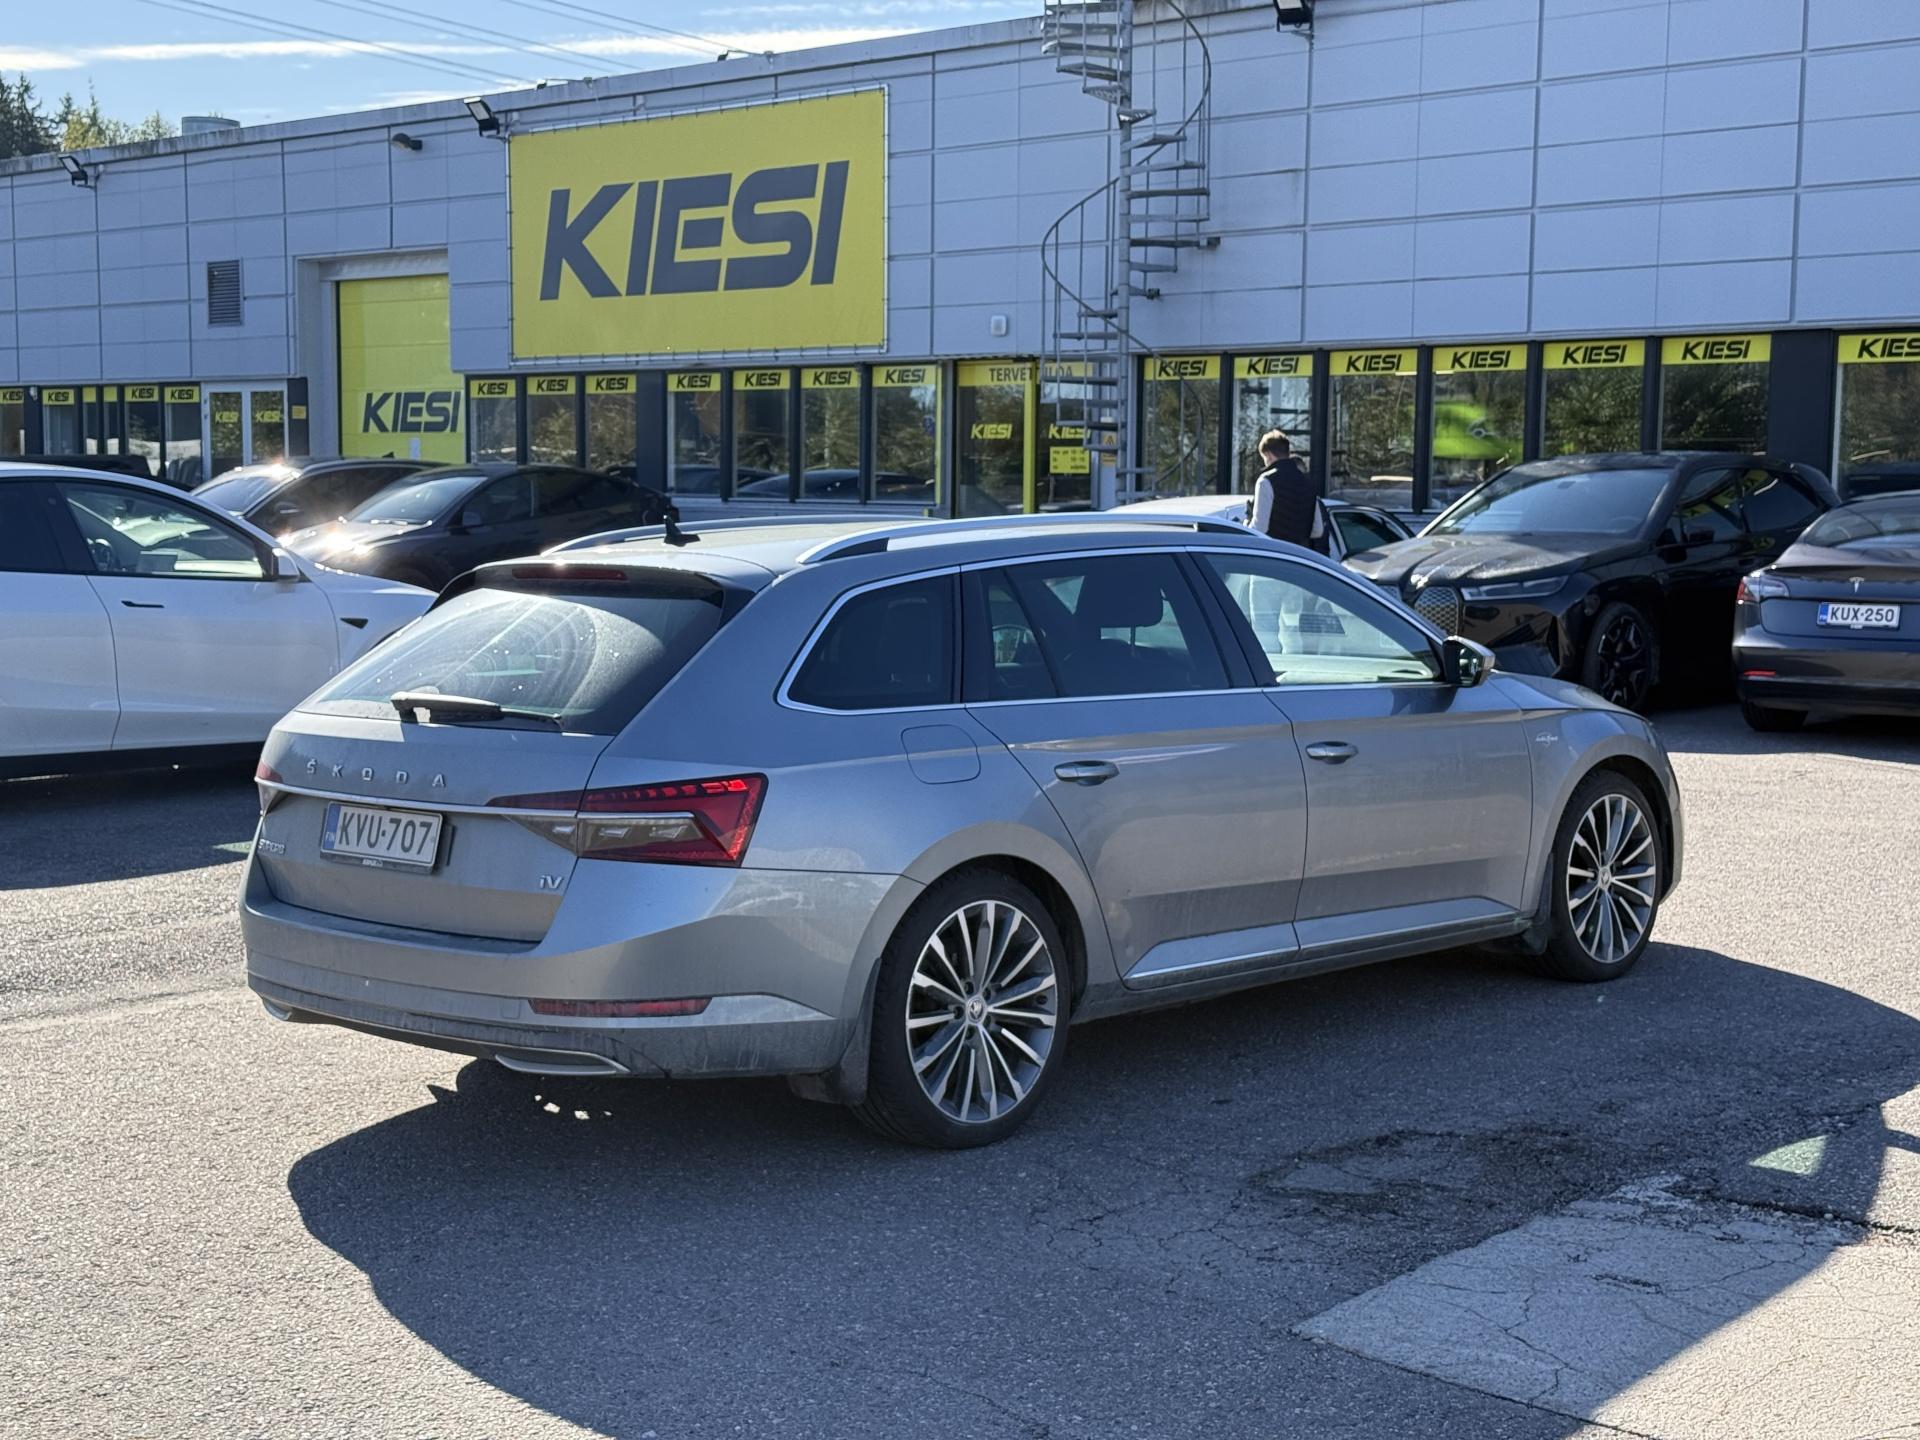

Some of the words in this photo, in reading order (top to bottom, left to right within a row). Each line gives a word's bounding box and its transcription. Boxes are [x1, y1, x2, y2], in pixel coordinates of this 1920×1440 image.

[540, 160, 849, 301] KIESI
[1562, 345, 1627, 365] KIESI
[1681, 340, 1751, 361] KIESI
[1247, 357, 1299, 375] KIESI
[1346, 354, 1401, 373] KIESI
[1451, 350, 1510, 369] KIESI
[885, 368, 925, 384] KIESI
[1158, 360, 1206, 377] KIESI
[536, 379, 568, 392] KIESI
[595, 377, 628, 391] KIESI
[676, 374, 712, 389] KIESI
[744, 372, 781, 387] KIESI
[813, 370, 851, 386] KIESI
[47, 391, 70, 402] KIESI
[131, 387, 155, 400] KIESI
[170, 388, 194, 401] KIESI
[477, 382, 508, 395] KIESI
[362, 391, 462, 433] KIESI
[970, 423, 1012, 439] KIESI
[1830, 606, 1895, 623] KUX-250
[306, 758, 446, 789] ŠKODA
[338, 811, 433, 856] KVU-707
